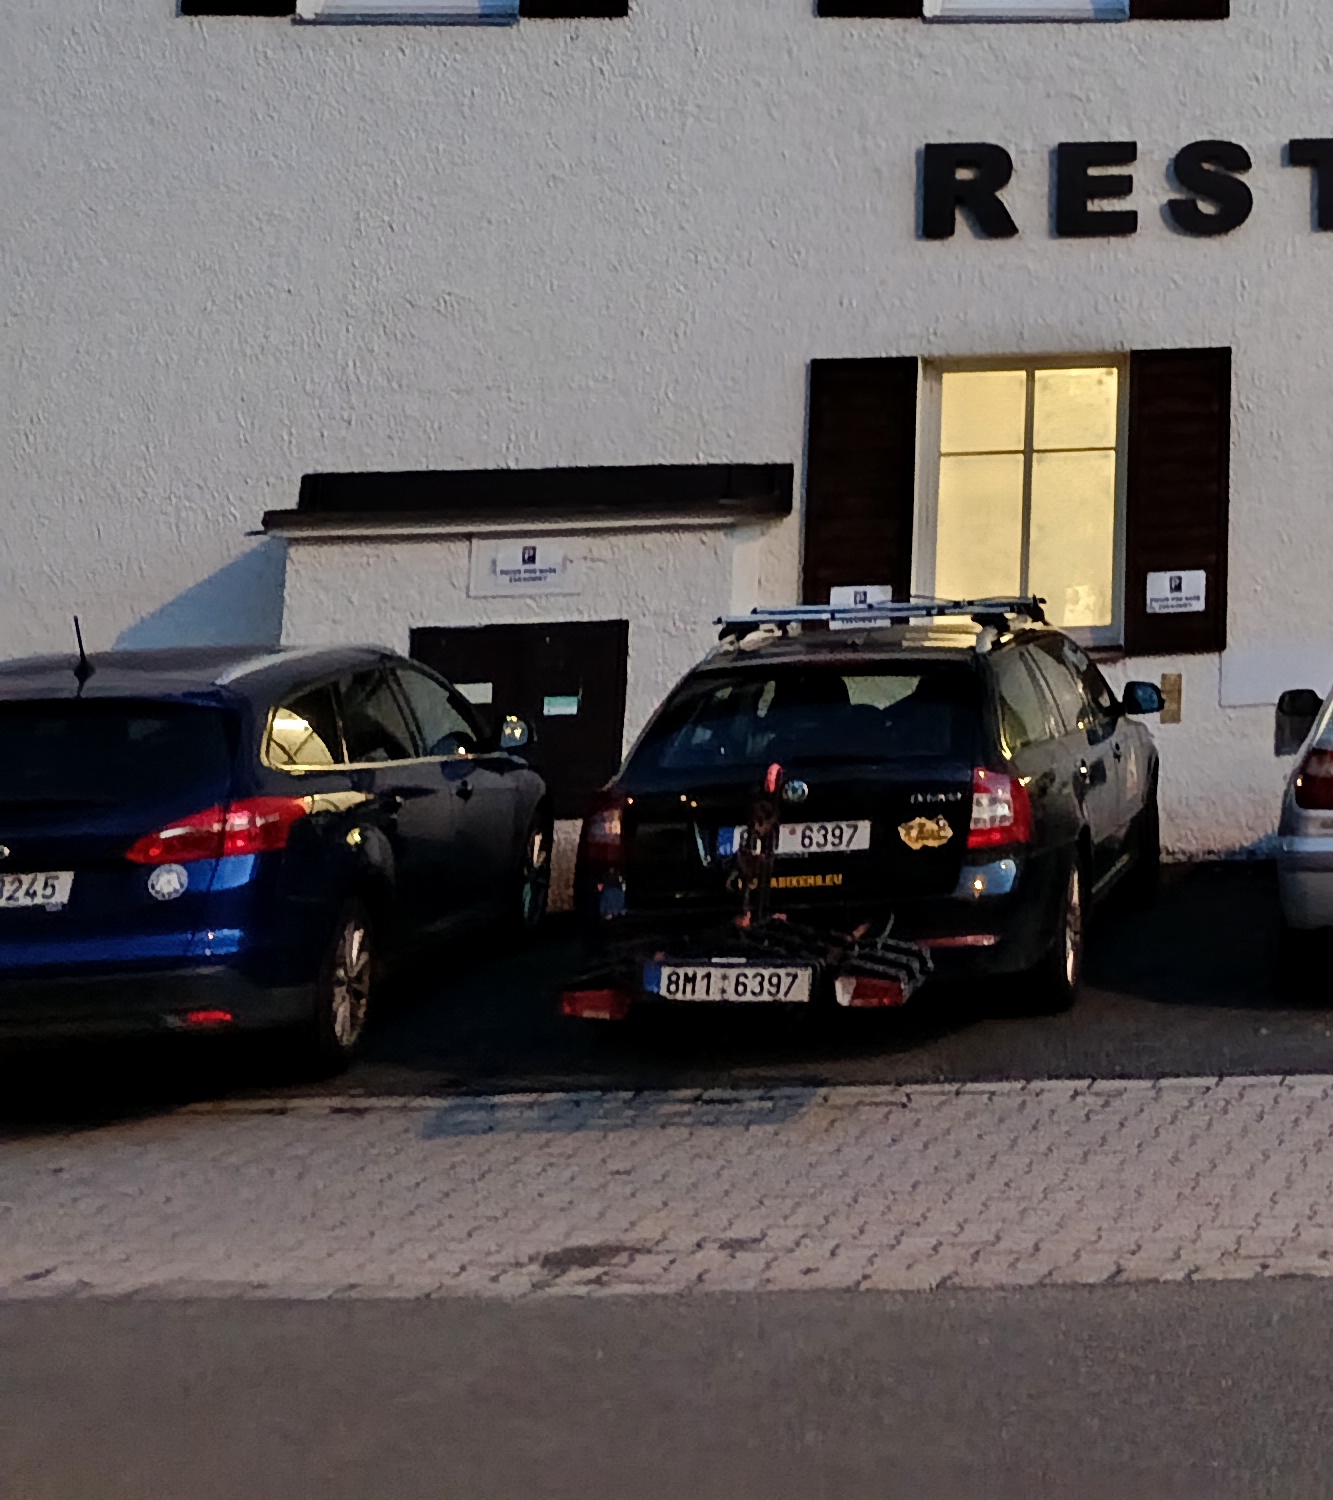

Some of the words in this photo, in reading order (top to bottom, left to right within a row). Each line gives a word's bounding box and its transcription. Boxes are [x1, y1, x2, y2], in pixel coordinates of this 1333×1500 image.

[800, 823, 860, 850] 6397
[665, 971, 714, 998] 8M1
[733, 970, 799, 998] 6397
